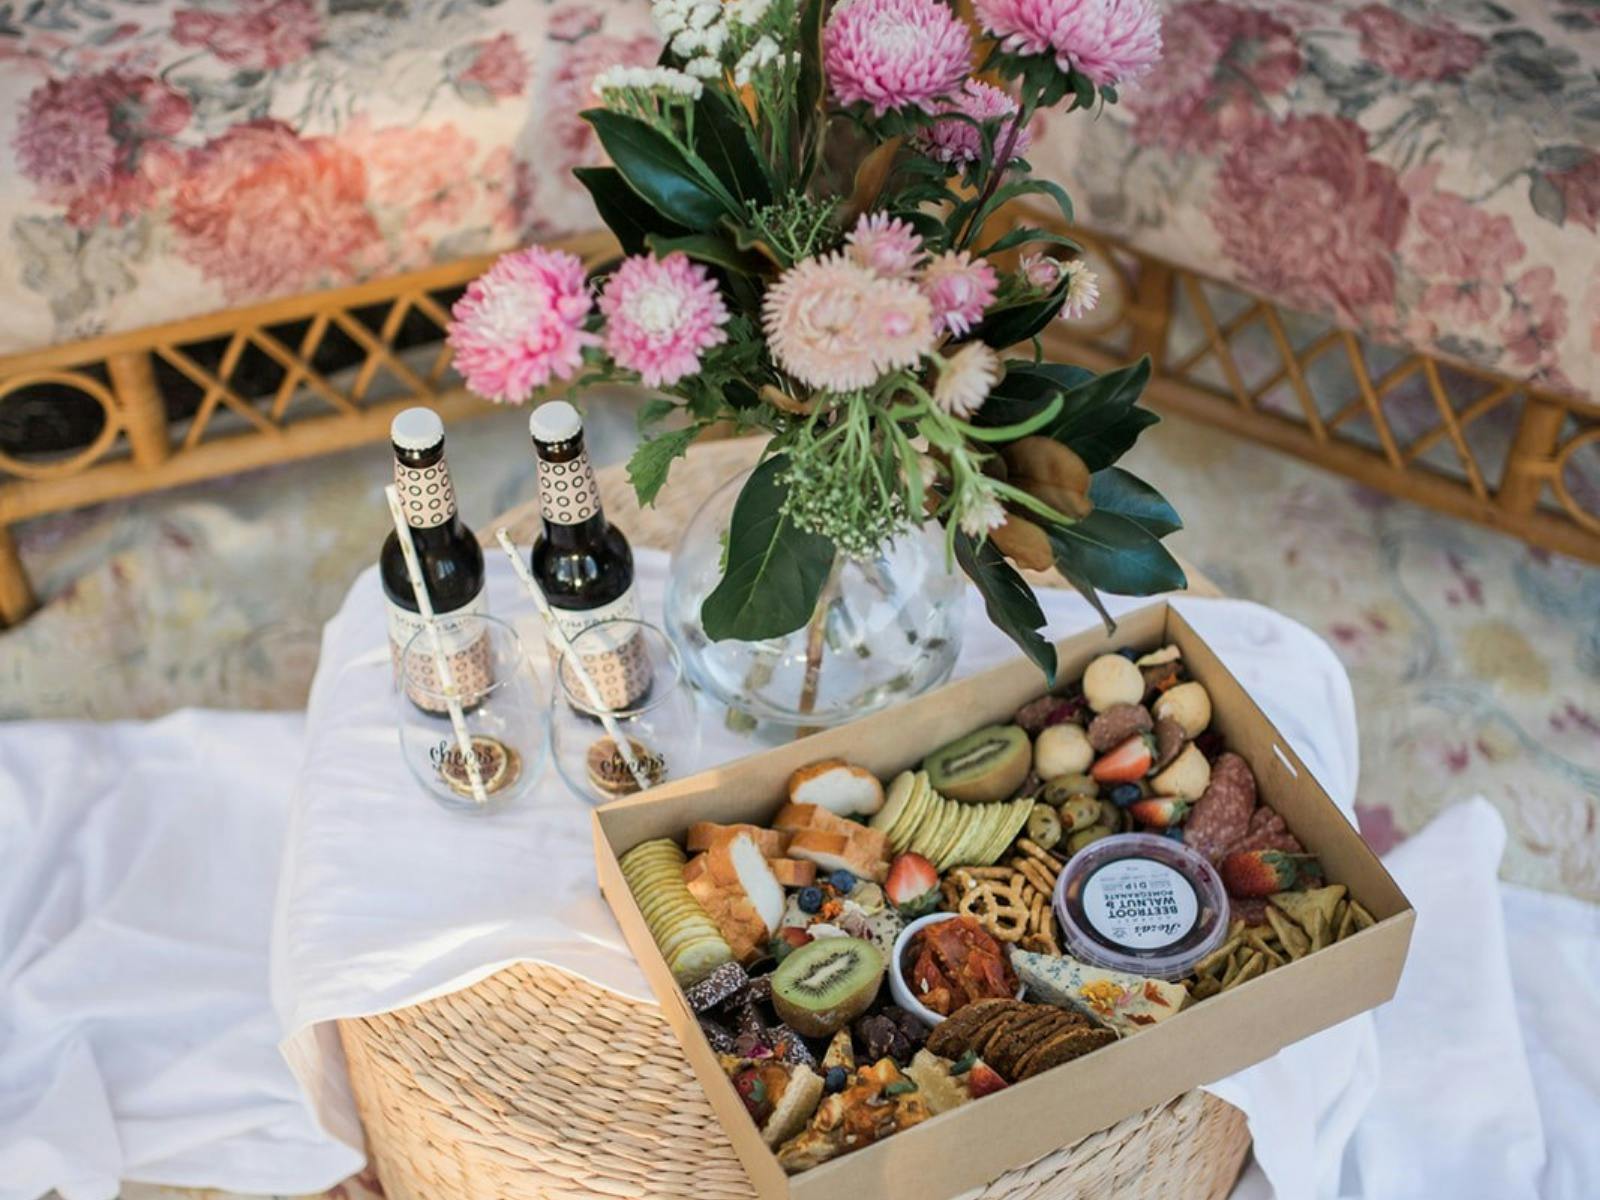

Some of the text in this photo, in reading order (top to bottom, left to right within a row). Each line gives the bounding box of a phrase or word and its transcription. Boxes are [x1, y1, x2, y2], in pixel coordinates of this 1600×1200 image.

[1124, 881, 1148, 890] DIP
[1104, 889, 1174, 900] POMEGRANATE
[1105, 896, 1176, 909] WALNUT &
[1108, 905, 1178, 919] BEETROOT
